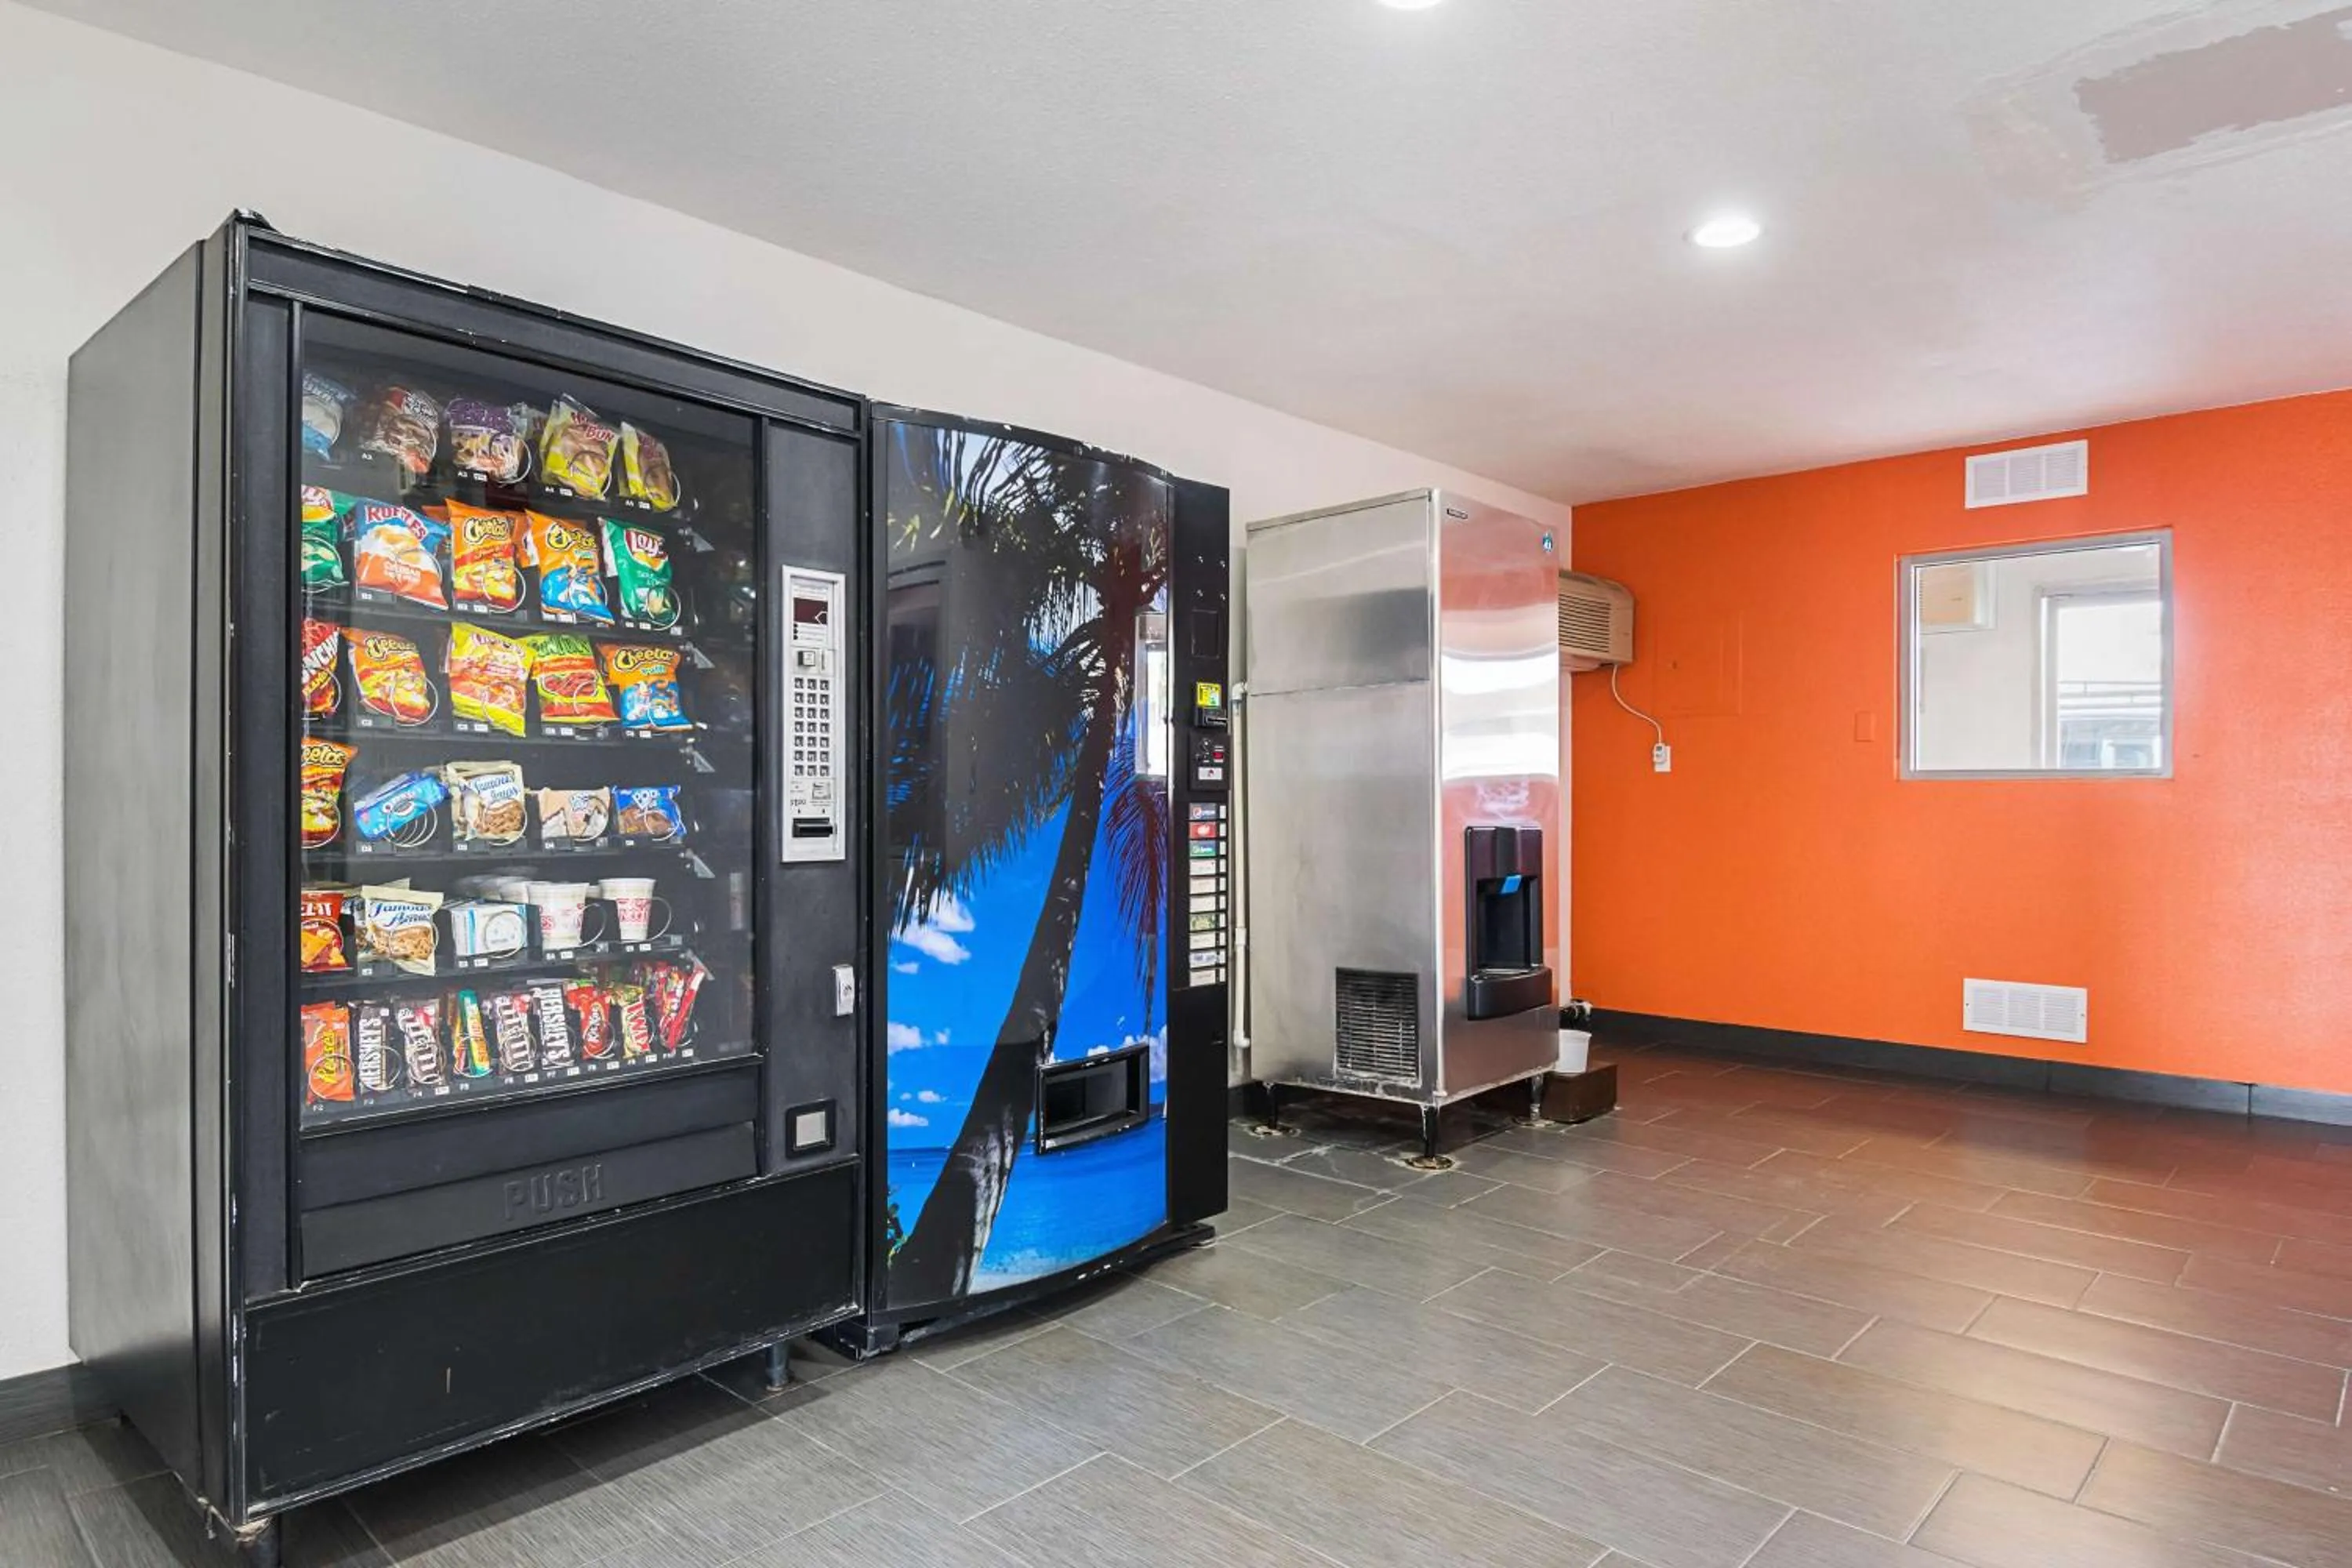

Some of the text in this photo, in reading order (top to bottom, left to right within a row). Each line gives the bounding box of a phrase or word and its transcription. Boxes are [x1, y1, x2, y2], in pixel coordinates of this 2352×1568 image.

[365, 504, 428, 541] RUFFLES
[358, 1017, 382, 1084] HERSHEY'S
[503, 1163, 604, 1221] PUSH
